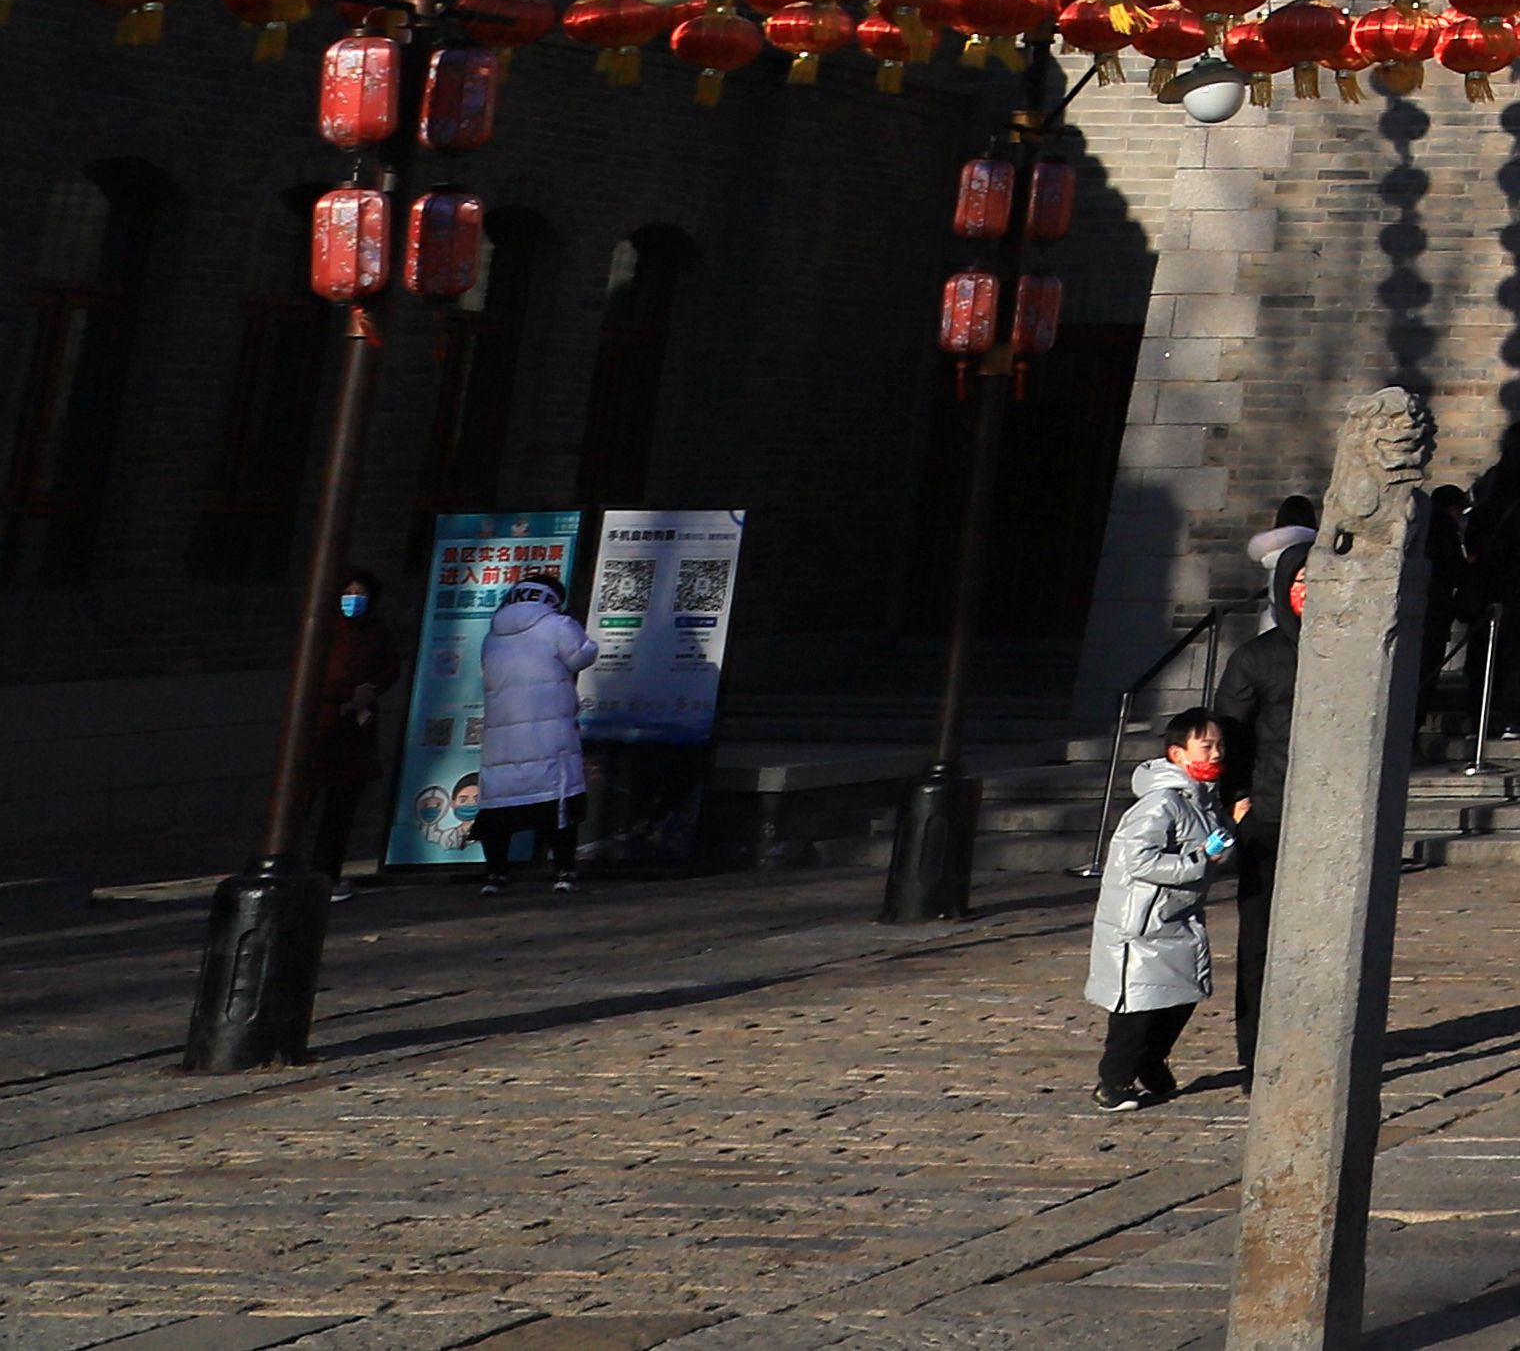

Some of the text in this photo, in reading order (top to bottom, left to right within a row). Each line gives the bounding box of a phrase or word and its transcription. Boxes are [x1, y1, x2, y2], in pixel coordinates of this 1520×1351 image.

[606, 528, 677, 543] 手机自助购票
[442, 545, 565, 563] 景区实名制购票
